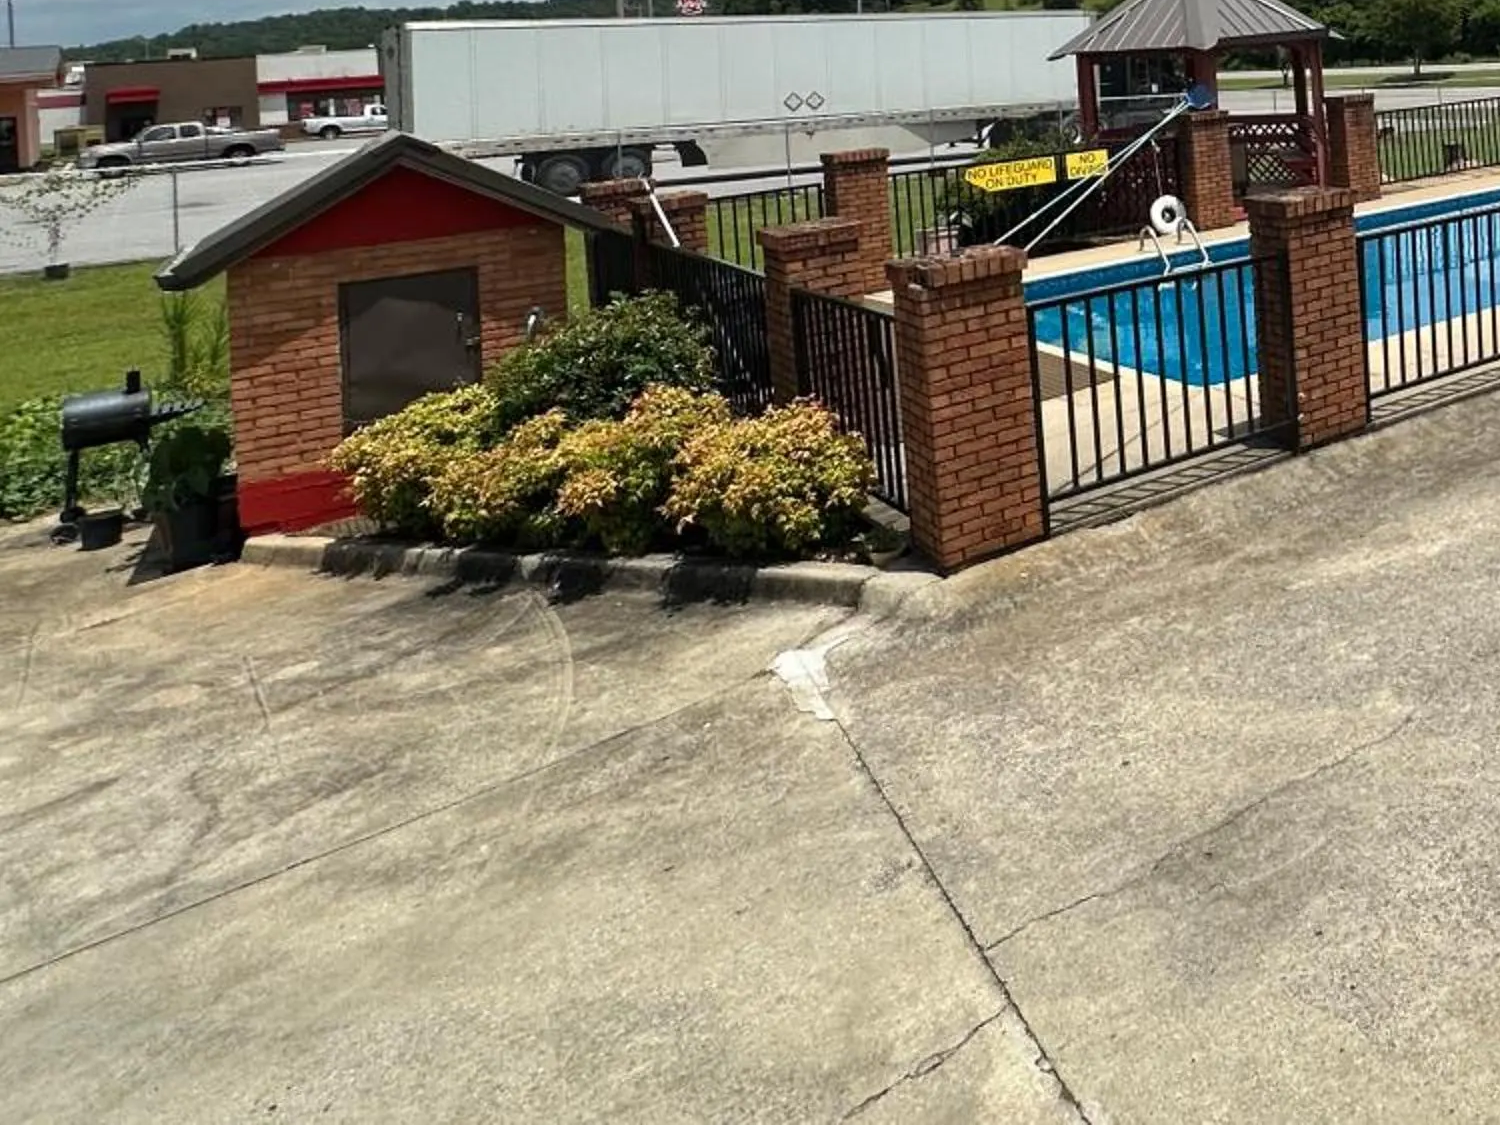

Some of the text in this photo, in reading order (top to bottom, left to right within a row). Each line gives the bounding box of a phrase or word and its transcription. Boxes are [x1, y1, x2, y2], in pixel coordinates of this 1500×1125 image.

[1079, 153, 1096, 164] NO
[967, 168, 987, 181] NO
[985, 173, 1037, 189] ON DUTY
